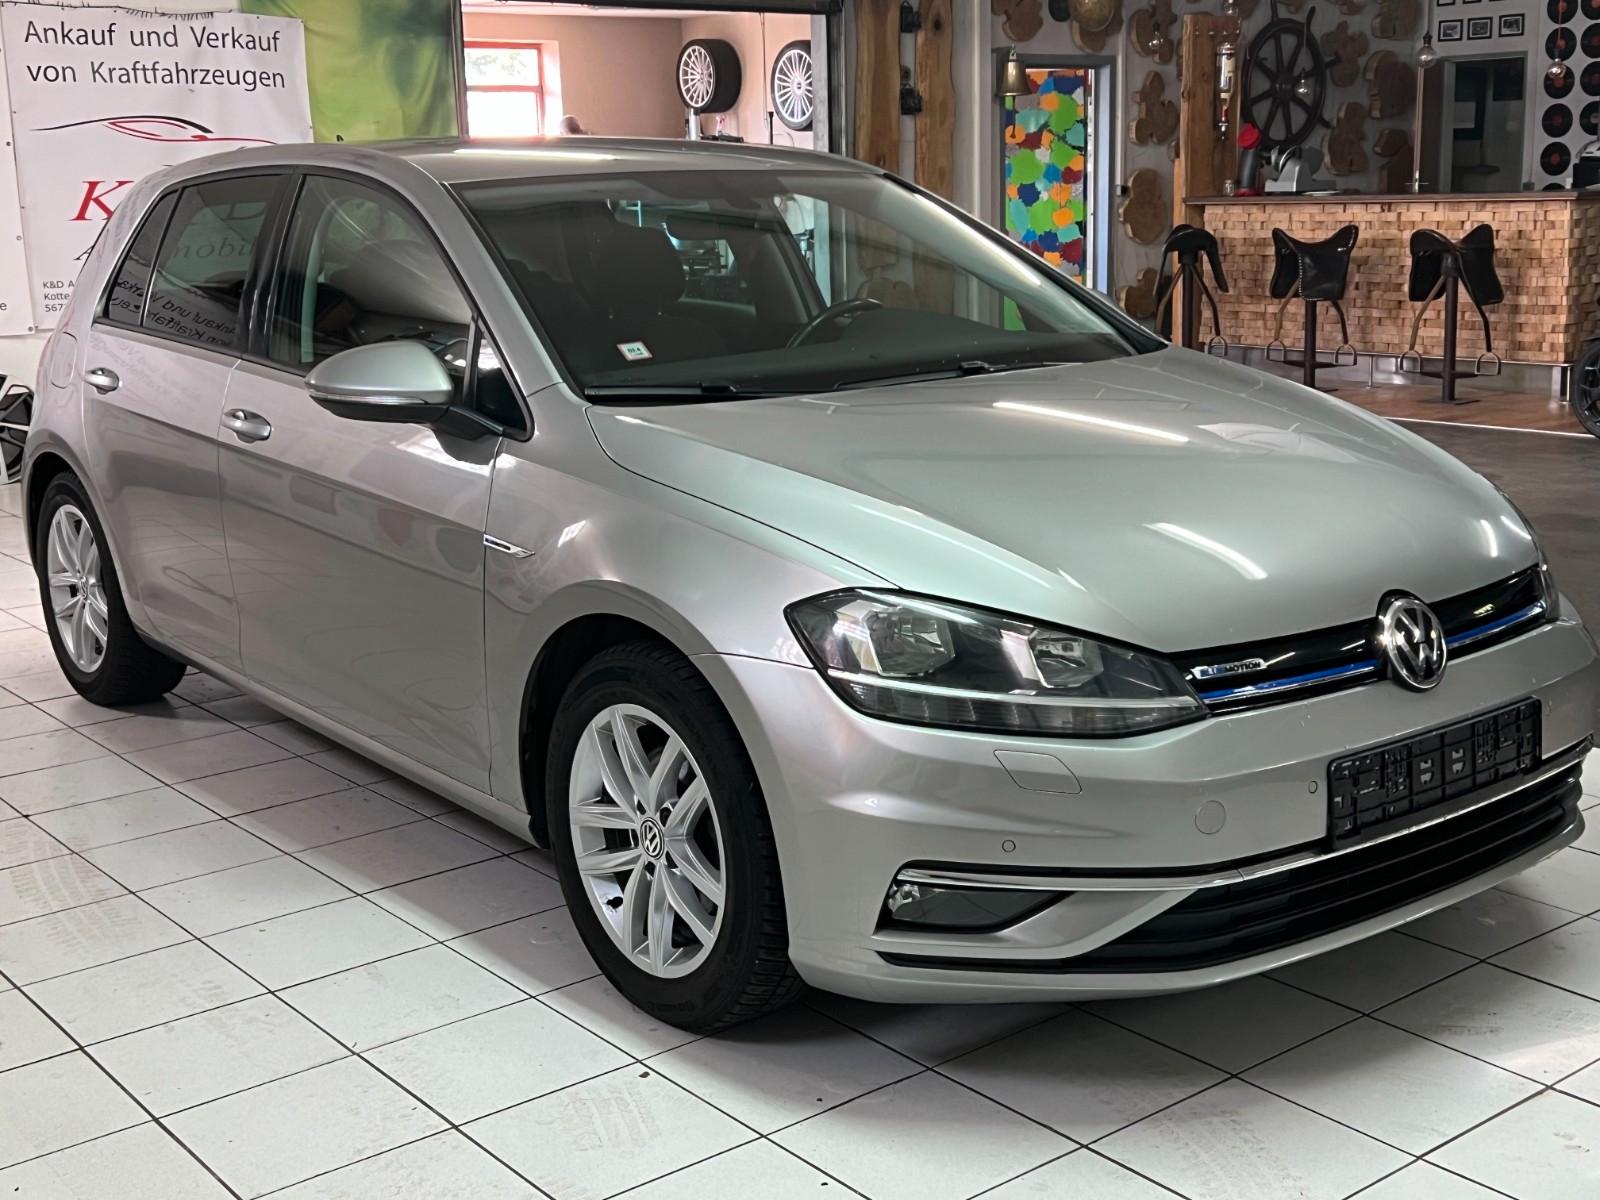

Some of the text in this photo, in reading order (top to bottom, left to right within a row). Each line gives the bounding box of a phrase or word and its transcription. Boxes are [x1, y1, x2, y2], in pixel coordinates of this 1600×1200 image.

[24, 20, 281, 53] Ankauf und Verkauf
[26, 60, 286, 92] von Kraftfahrzeugen
[43, 280, 64, 289] K&D
[45, 303, 65, 312] 567
